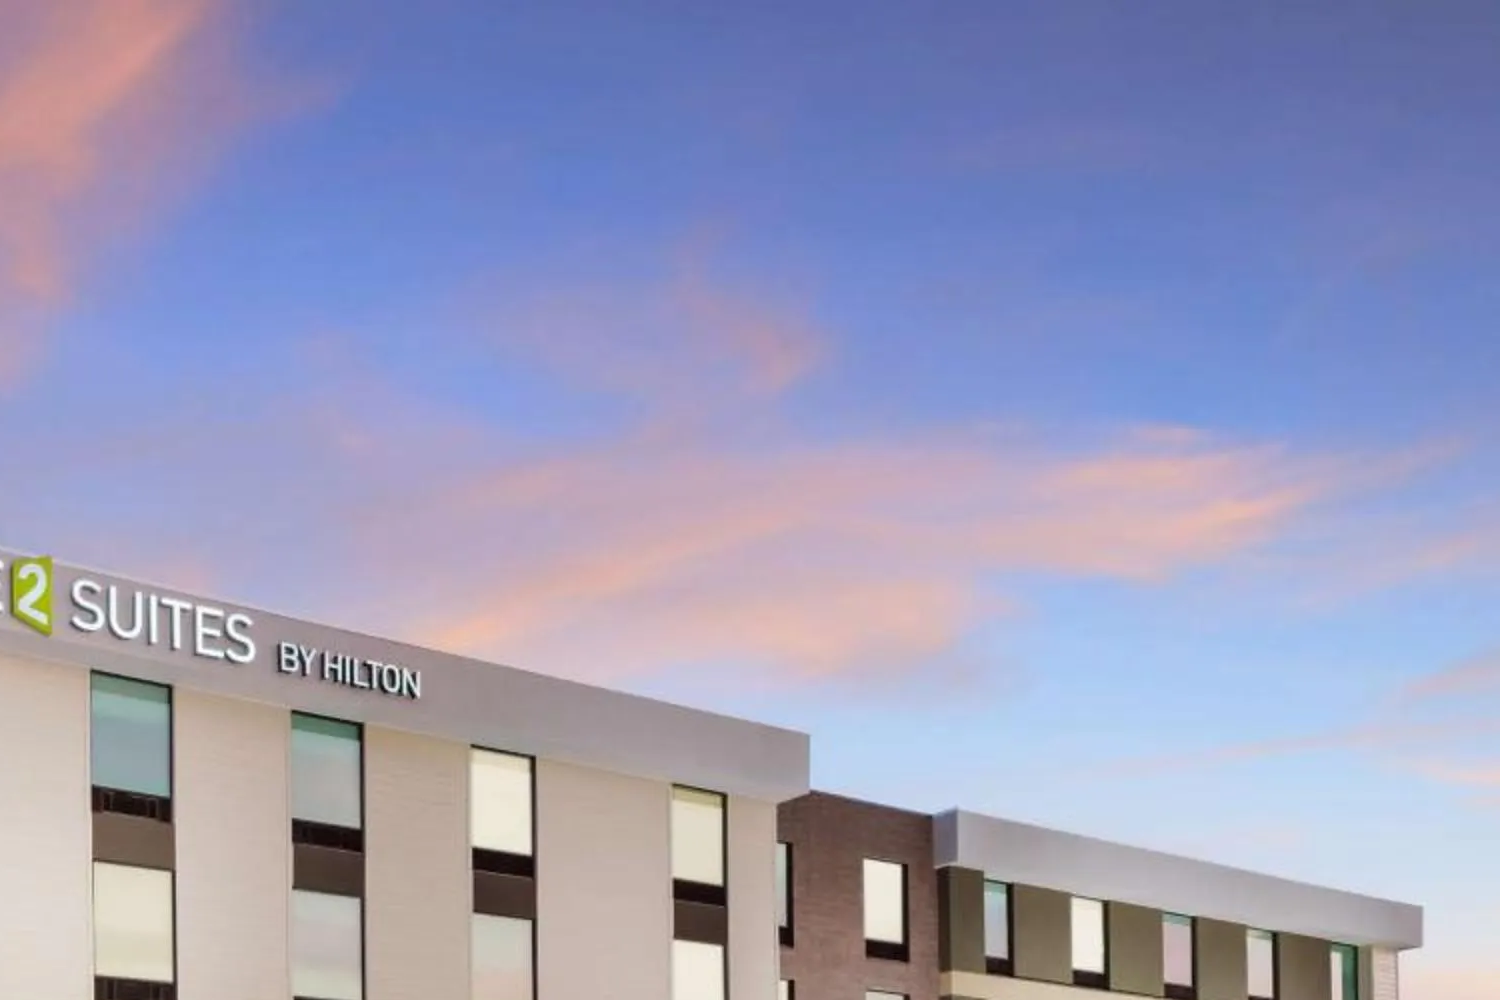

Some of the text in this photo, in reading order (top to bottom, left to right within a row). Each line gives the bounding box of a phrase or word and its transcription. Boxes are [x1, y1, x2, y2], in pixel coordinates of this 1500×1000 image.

[14, 561, 50, 627] 2
[70, 577, 257, 665] SUITES
[278, 640, 317, 677] BY
[322, 652, 422, 699] HILTON
